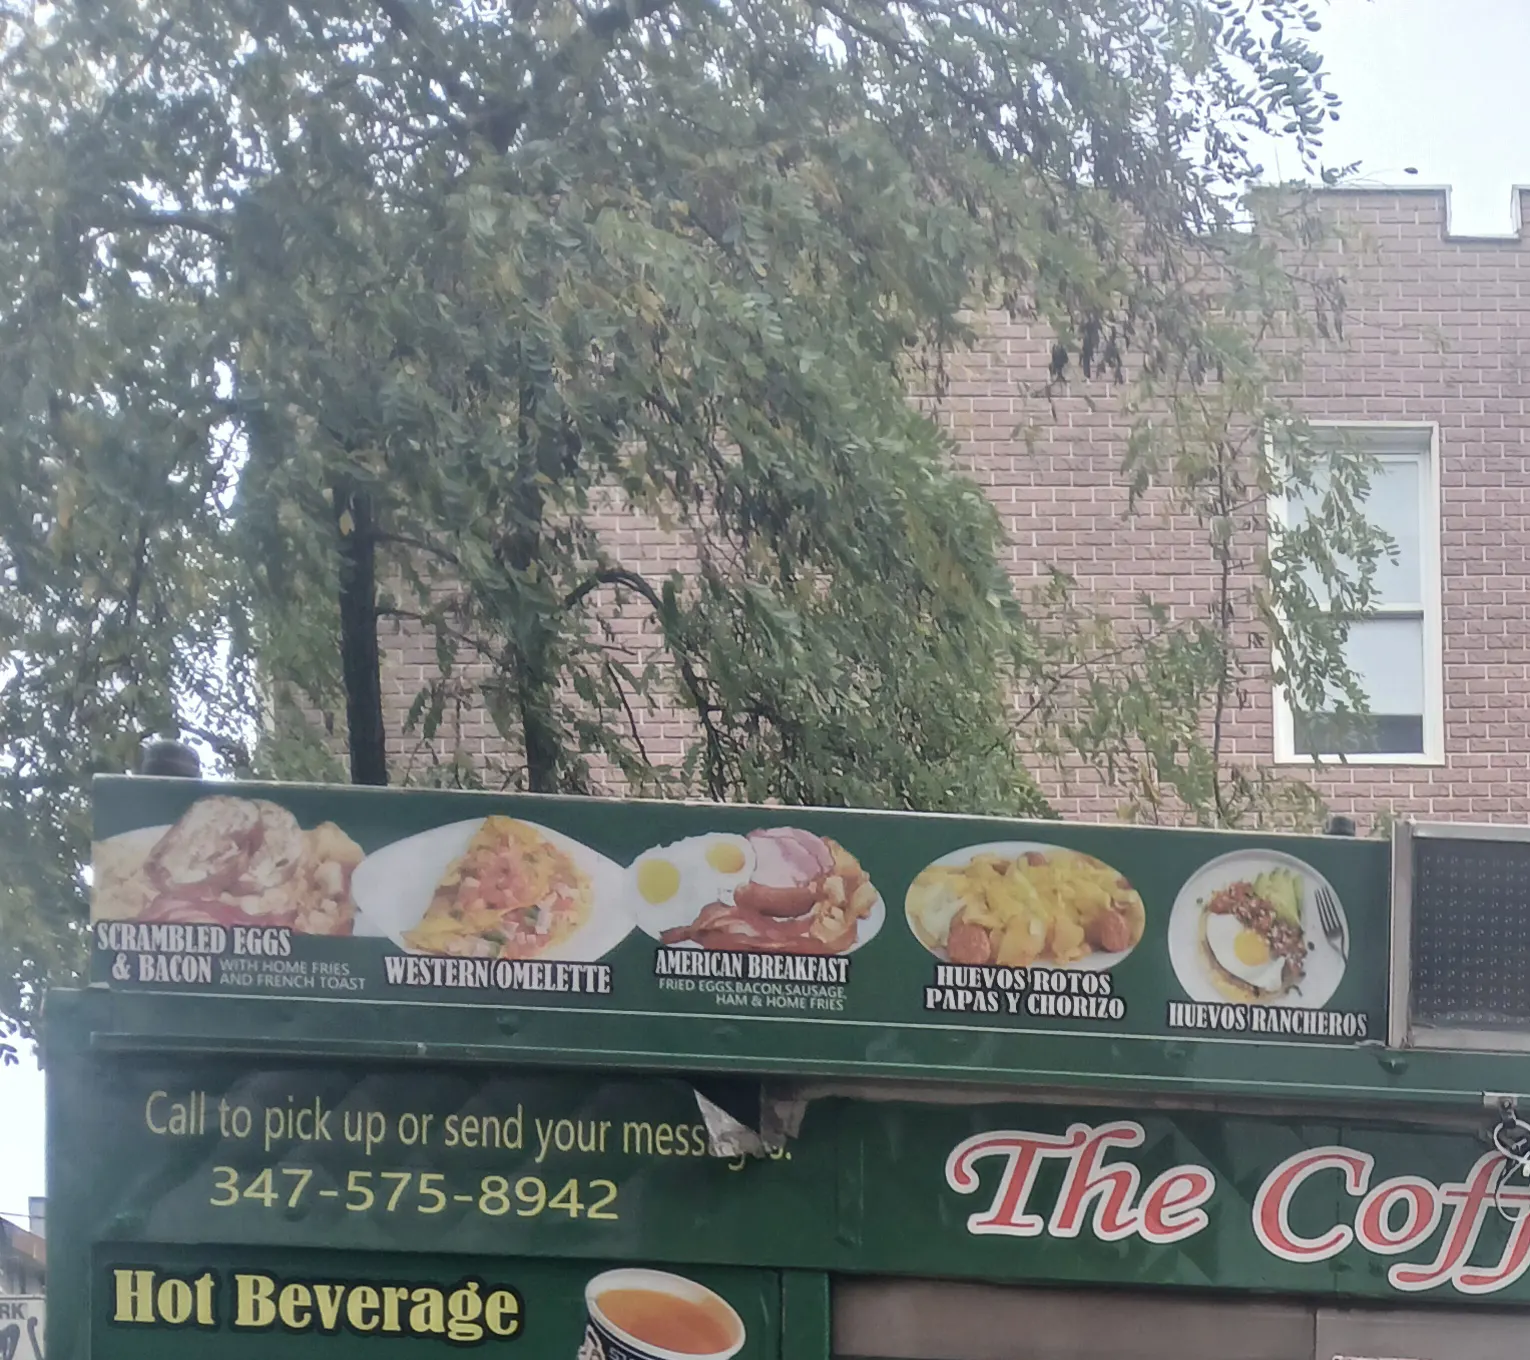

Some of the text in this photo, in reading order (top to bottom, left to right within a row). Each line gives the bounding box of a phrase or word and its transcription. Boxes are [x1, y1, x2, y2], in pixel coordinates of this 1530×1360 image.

[97, 922, 291, 956] SCRAMBLED EGGS
[112, 953, 212, 983] & BACON
[220, 959, 349, 976] WITH HOME FRIES
[220, 972, 365, 990] AND FRENCH TOAST
[386, 956, 611, 994] WESTERN OMELETTE
[656, 950, 849, 982] AMERICAN BREAKFAST
[936, 965, 1111, 995] HUEVOS ROTOS
[925, 988, 1125, 1019] PAPAS Y CHORIZO
[1169, 1005, 1368, 1038] HUEVOS RANCHEROS
[145, 1091, 204, 1137] Call
[219, 1099, 251, 1139] to
[264, 1101, 331, 1142] pick
[344, 1110, 386, 1148] up
[399, 1110, 430, 1144] or
[444, 1105, 522, 1151] send
[536, 1116, 609, 1163] your
[210, 1165, 619, 1219] 347-575-8942
[946, 1121, 1217, 1244] The
[113, 1269, 519, 1341] Hot Beverage
